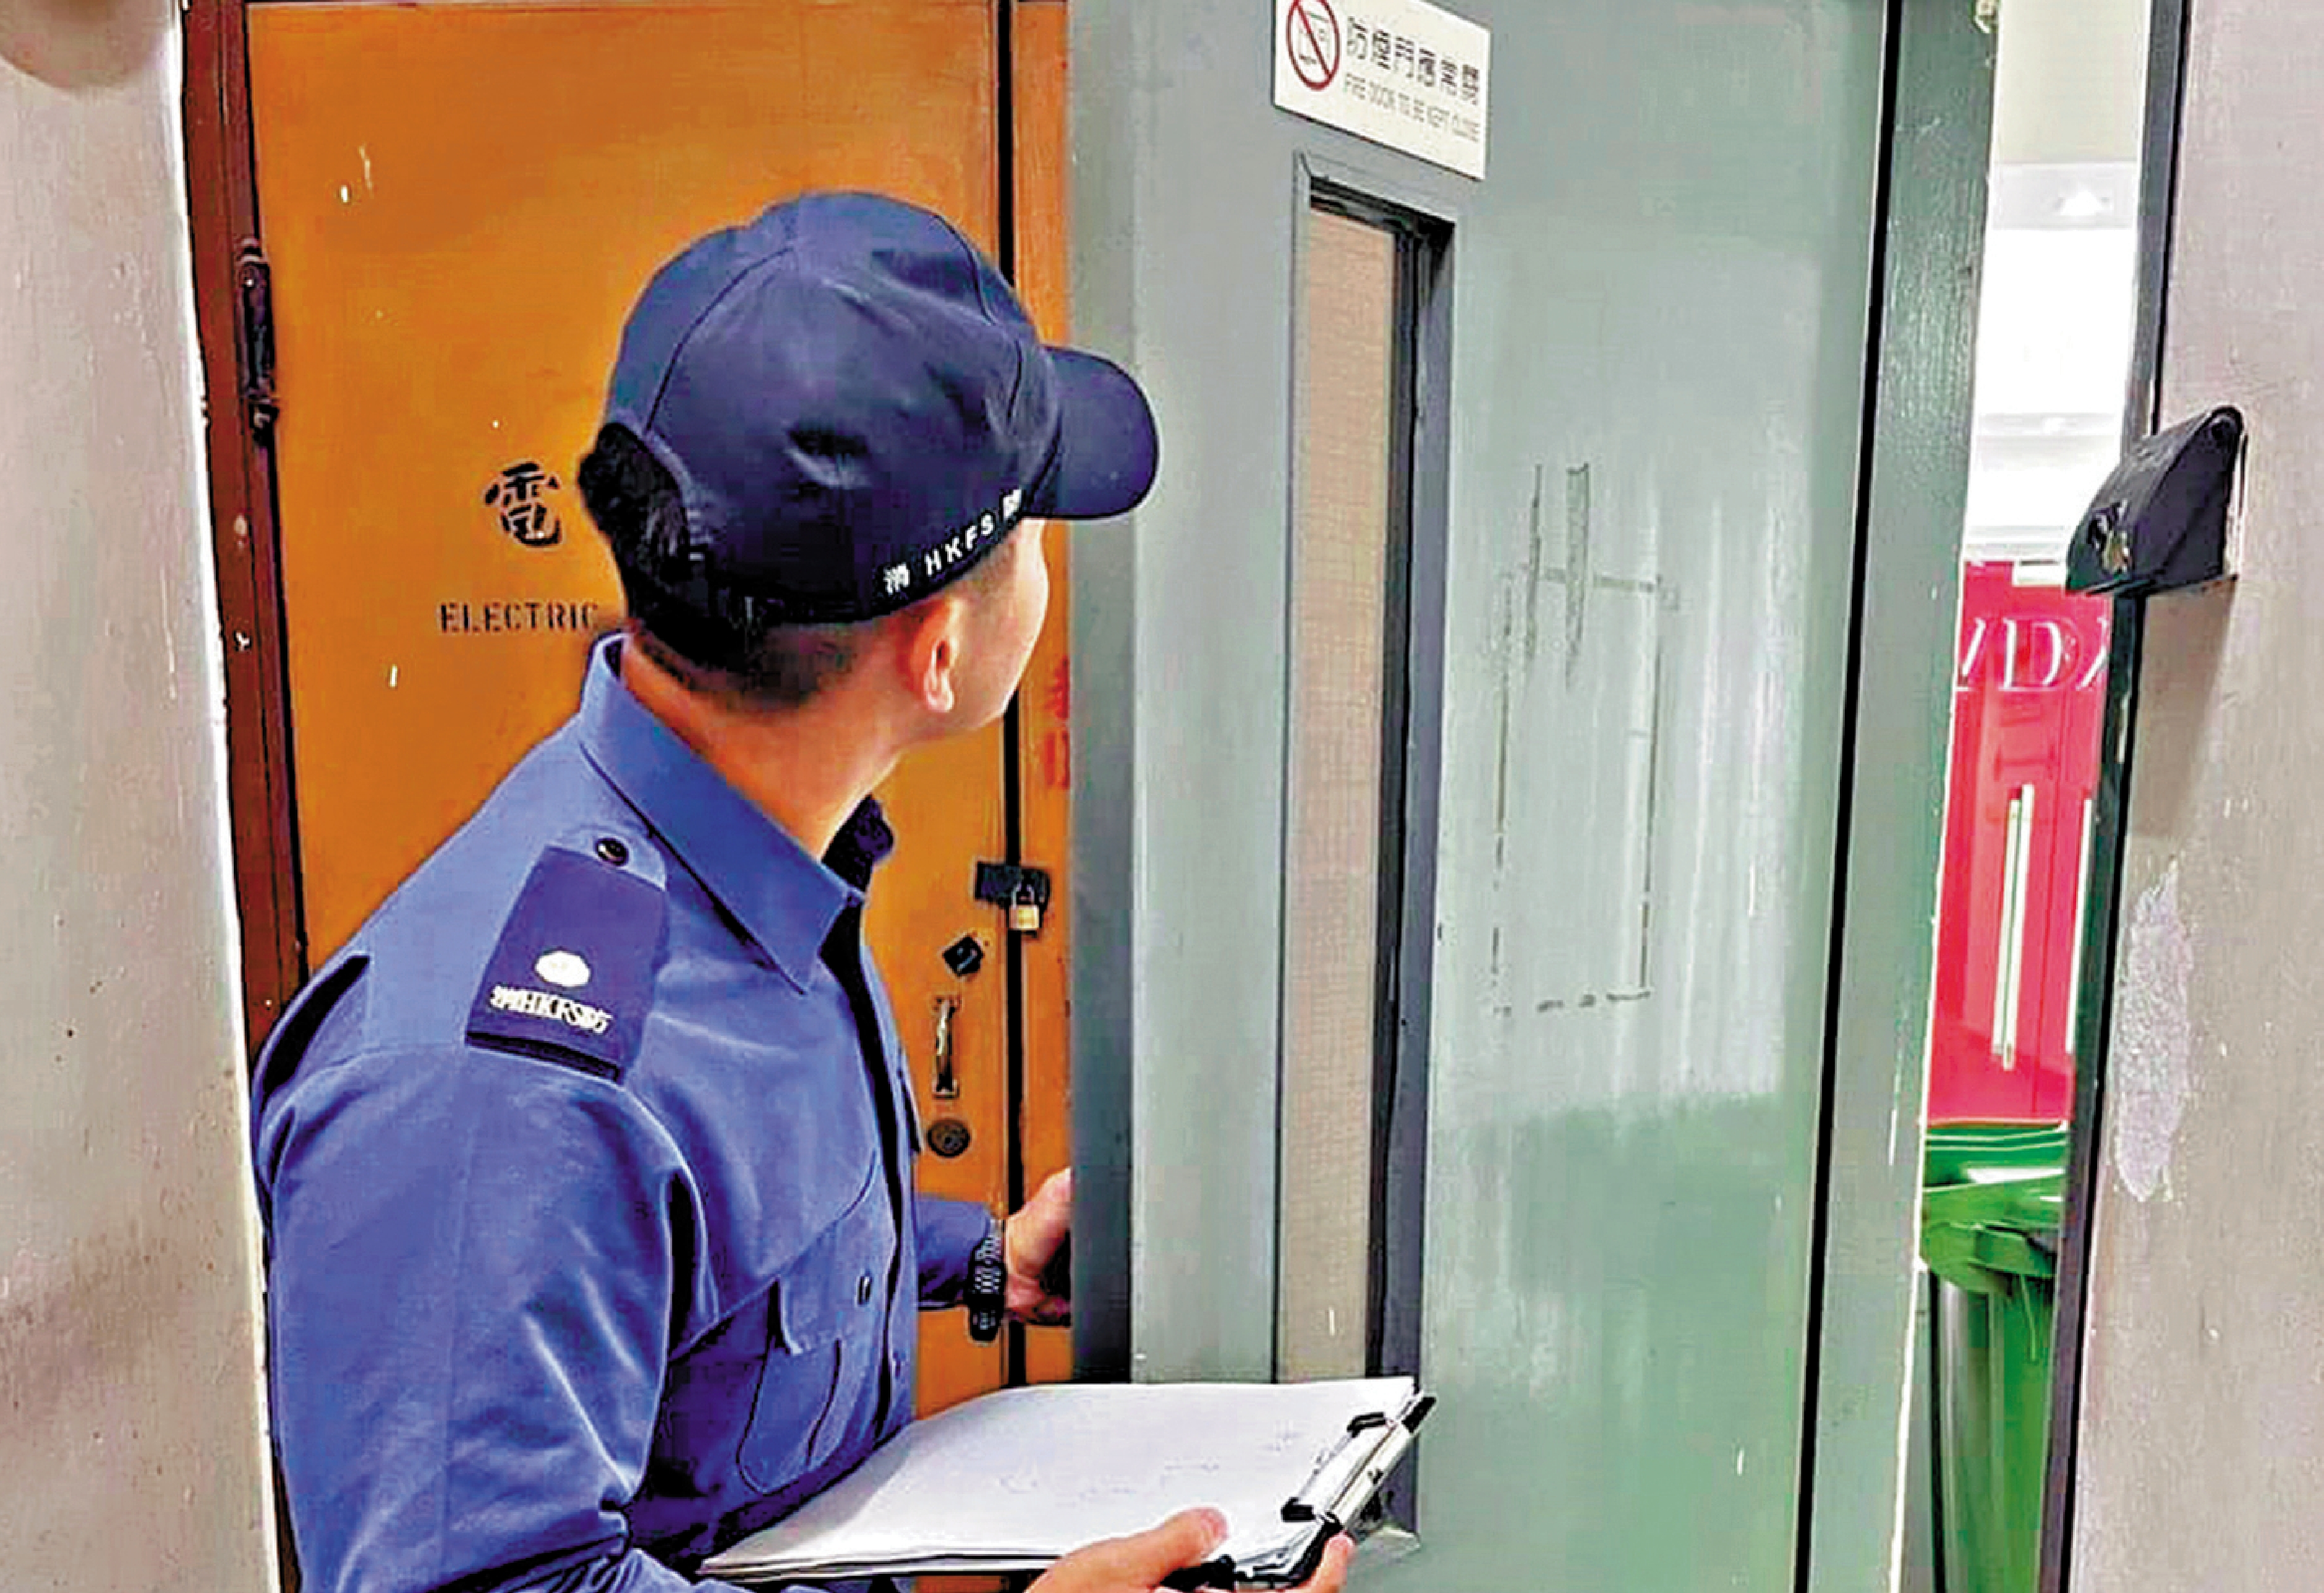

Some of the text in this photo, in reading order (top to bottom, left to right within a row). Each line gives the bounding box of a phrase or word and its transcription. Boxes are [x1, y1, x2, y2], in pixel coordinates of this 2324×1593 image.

[484, 462, 561, 545] 電
[924, 514, 994, 577] HKFS
[440, 601, 600, 633] ELECTRIC
